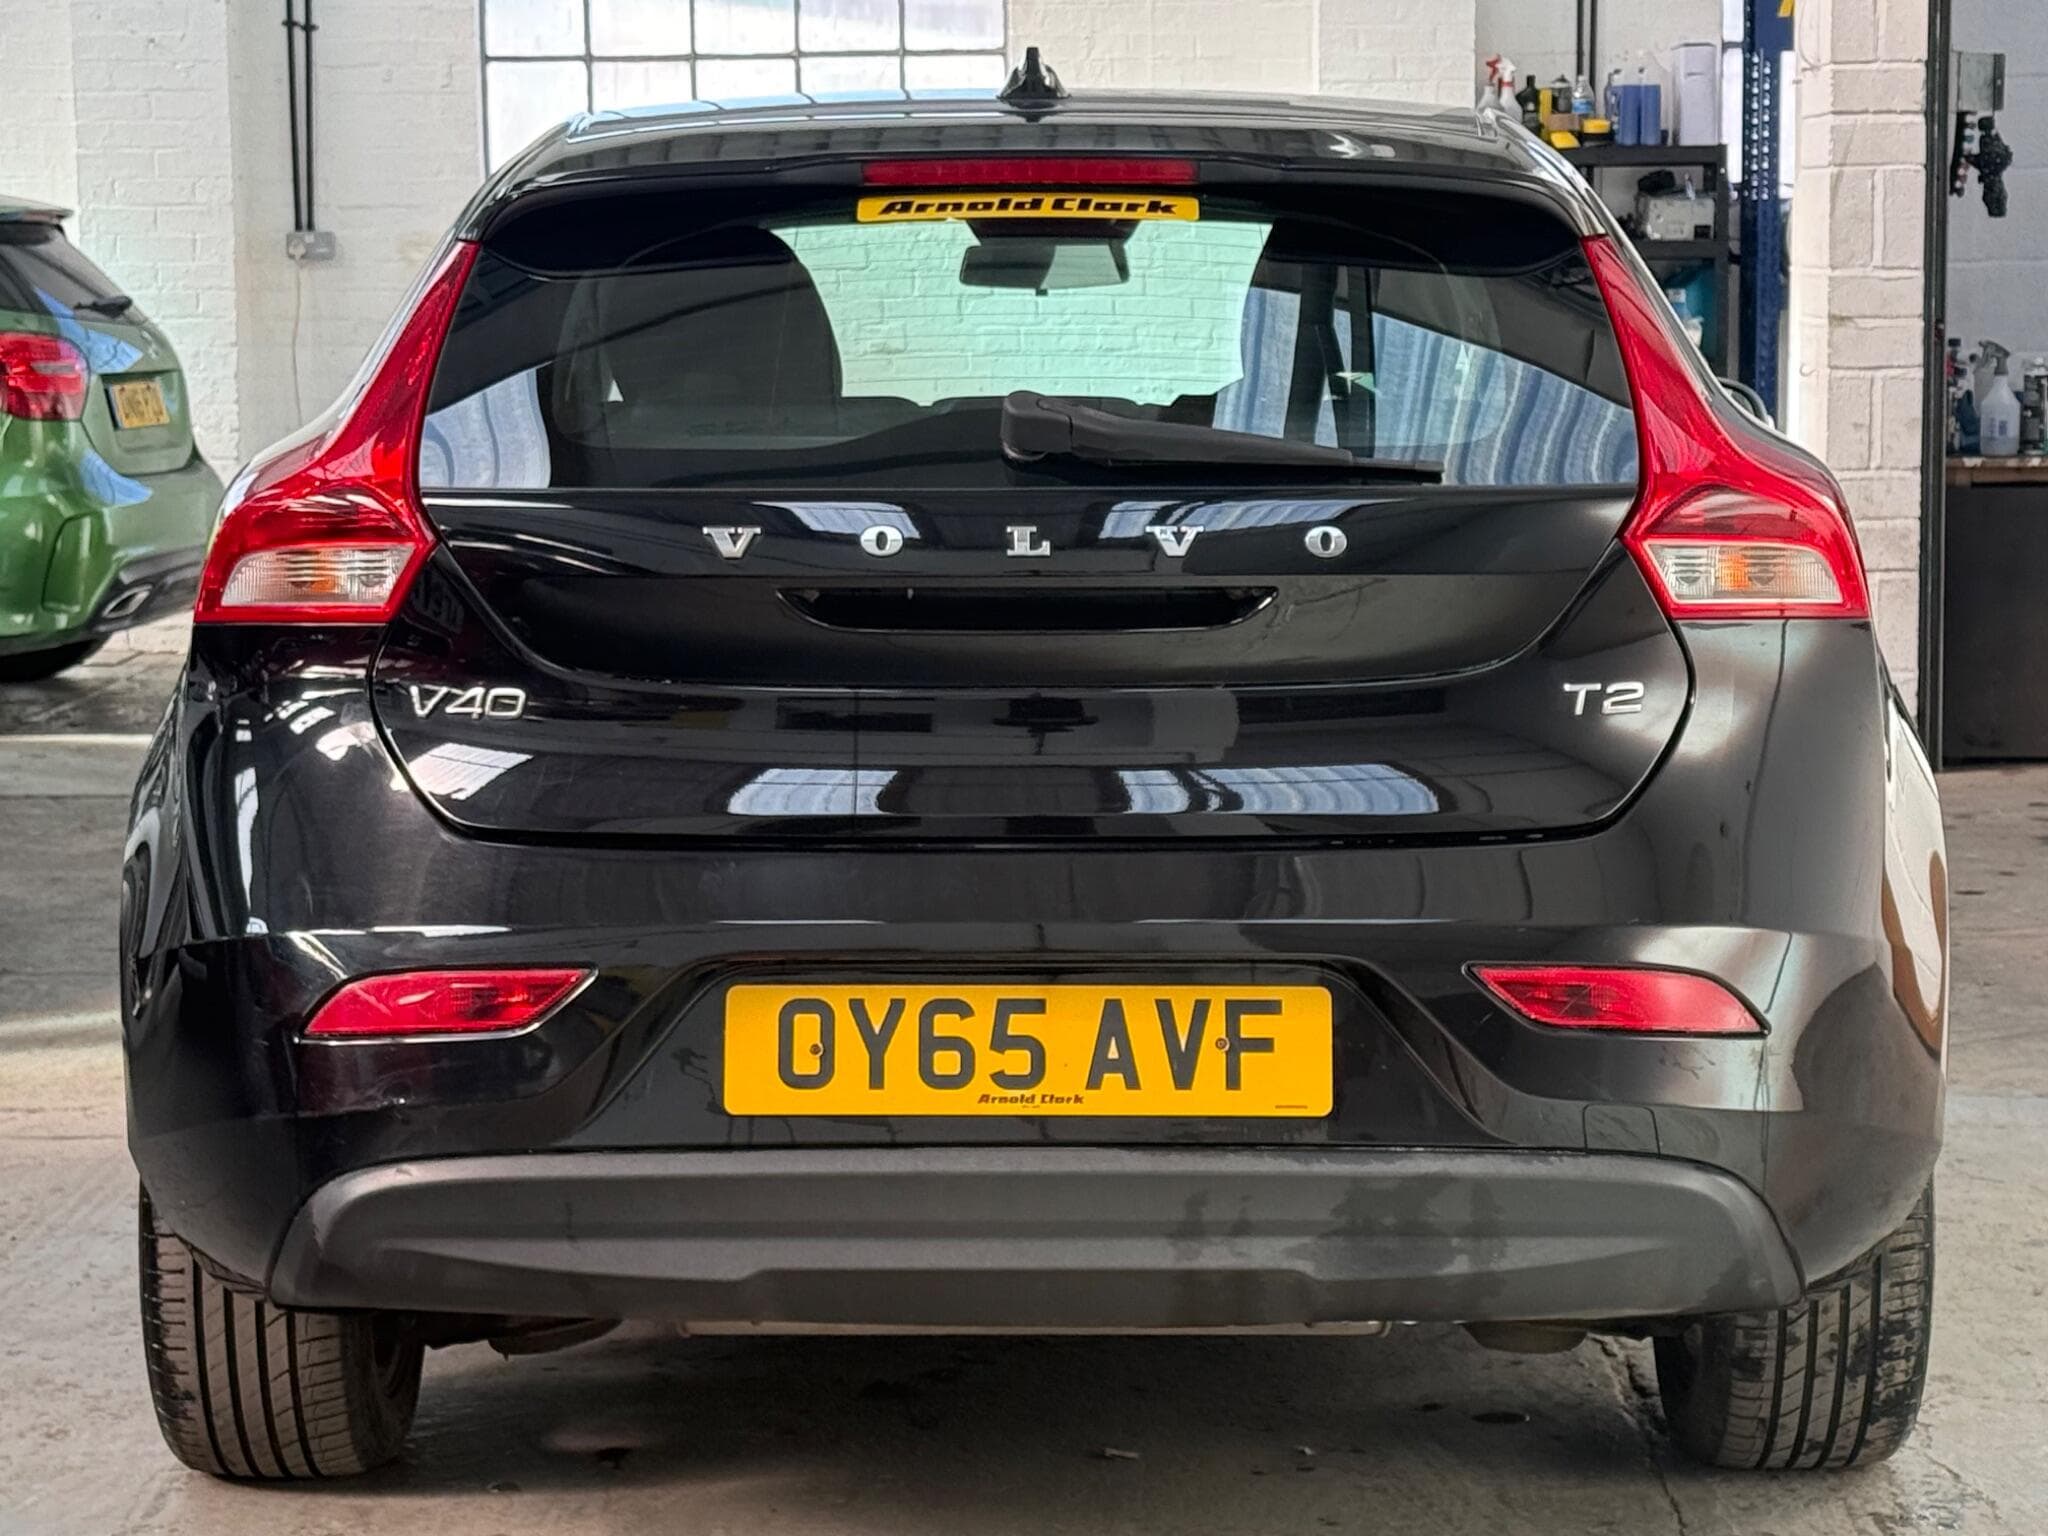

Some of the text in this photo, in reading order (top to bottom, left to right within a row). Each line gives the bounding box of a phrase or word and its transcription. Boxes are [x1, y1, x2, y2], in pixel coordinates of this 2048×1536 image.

[878, 198, 1178, 215] Arnold Clark
[702, 526, 1348, 558] VOLVO
[409, 685, 526, 718] V40
[1563, 681, 1644, 715] T2
[778, 998, 1283, 1090] OY65 AVF
[977, 1093, 1084, 1104] Arnold Clark
